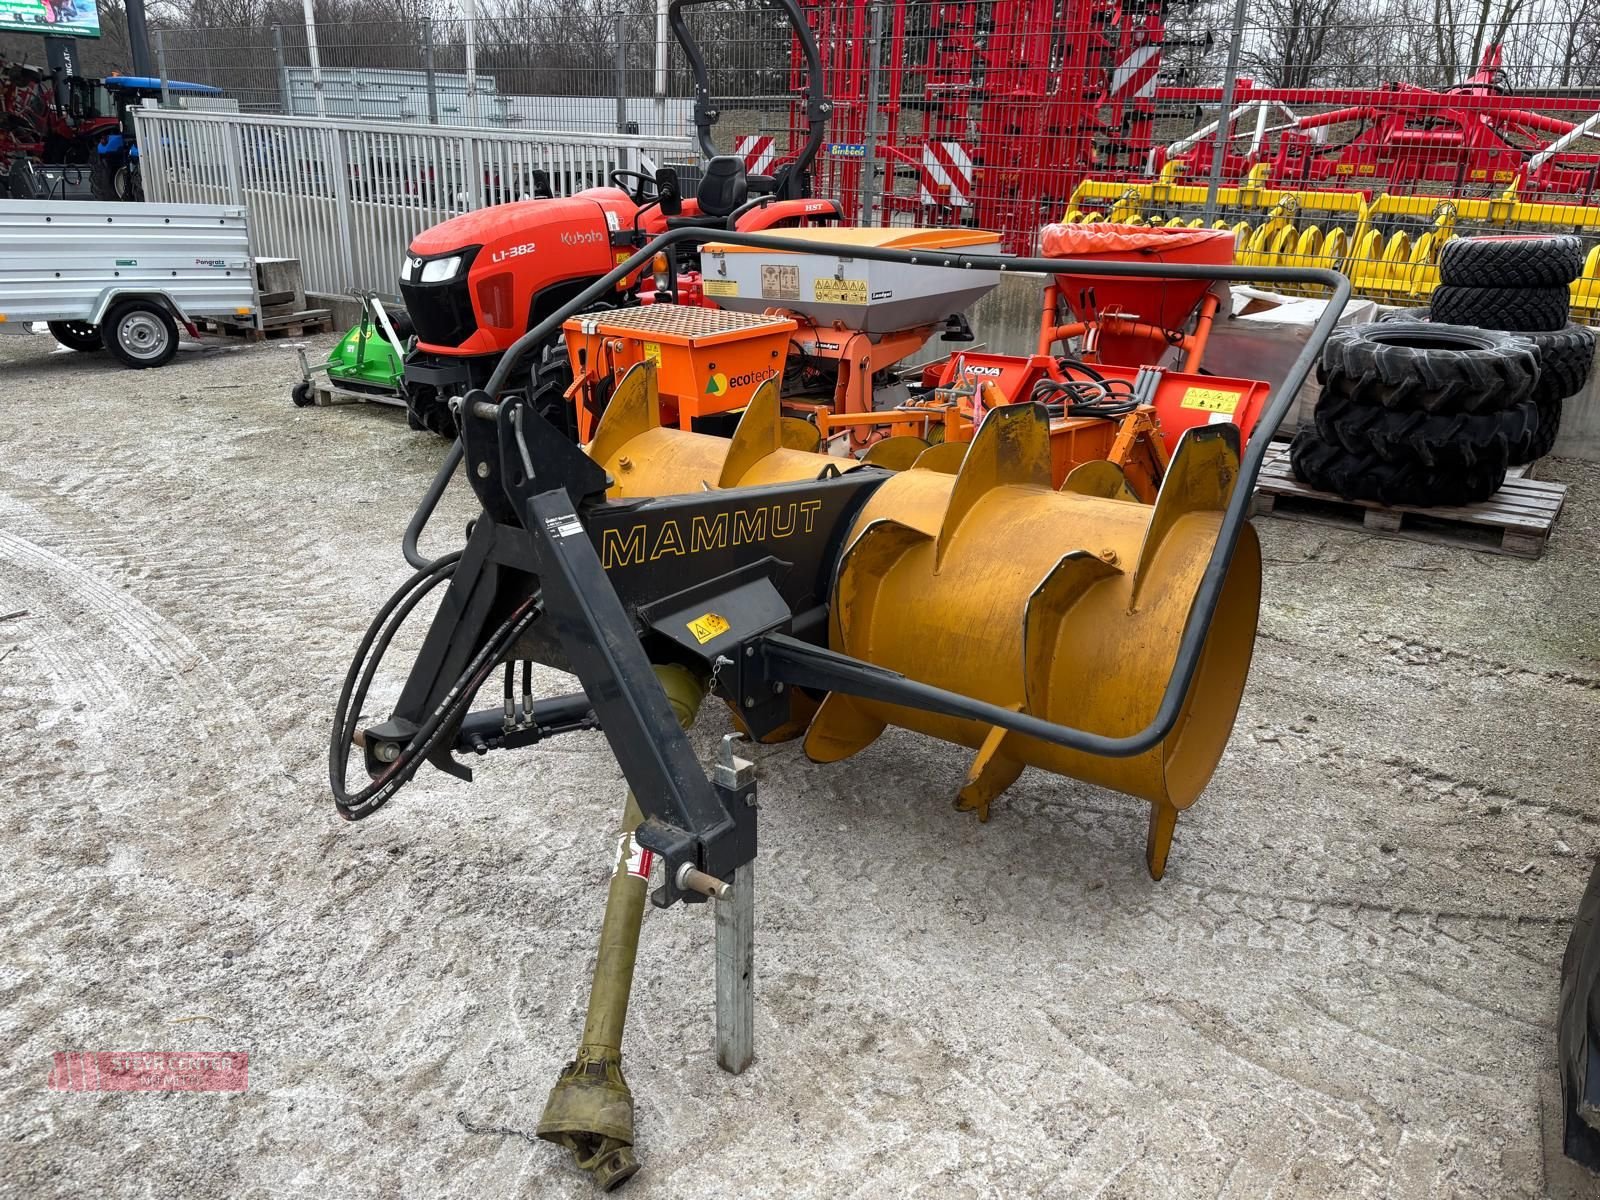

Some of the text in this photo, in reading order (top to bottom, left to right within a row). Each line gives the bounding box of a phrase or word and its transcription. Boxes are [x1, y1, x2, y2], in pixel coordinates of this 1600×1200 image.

[805, 203, 823, 212] HST
[561, 230, 604, 246] Kubota
[729, 365, 777, 389] ecotech
[964, 365, 1001, 377] KOVA
[601, 499, 822, 570] MAMMUT
